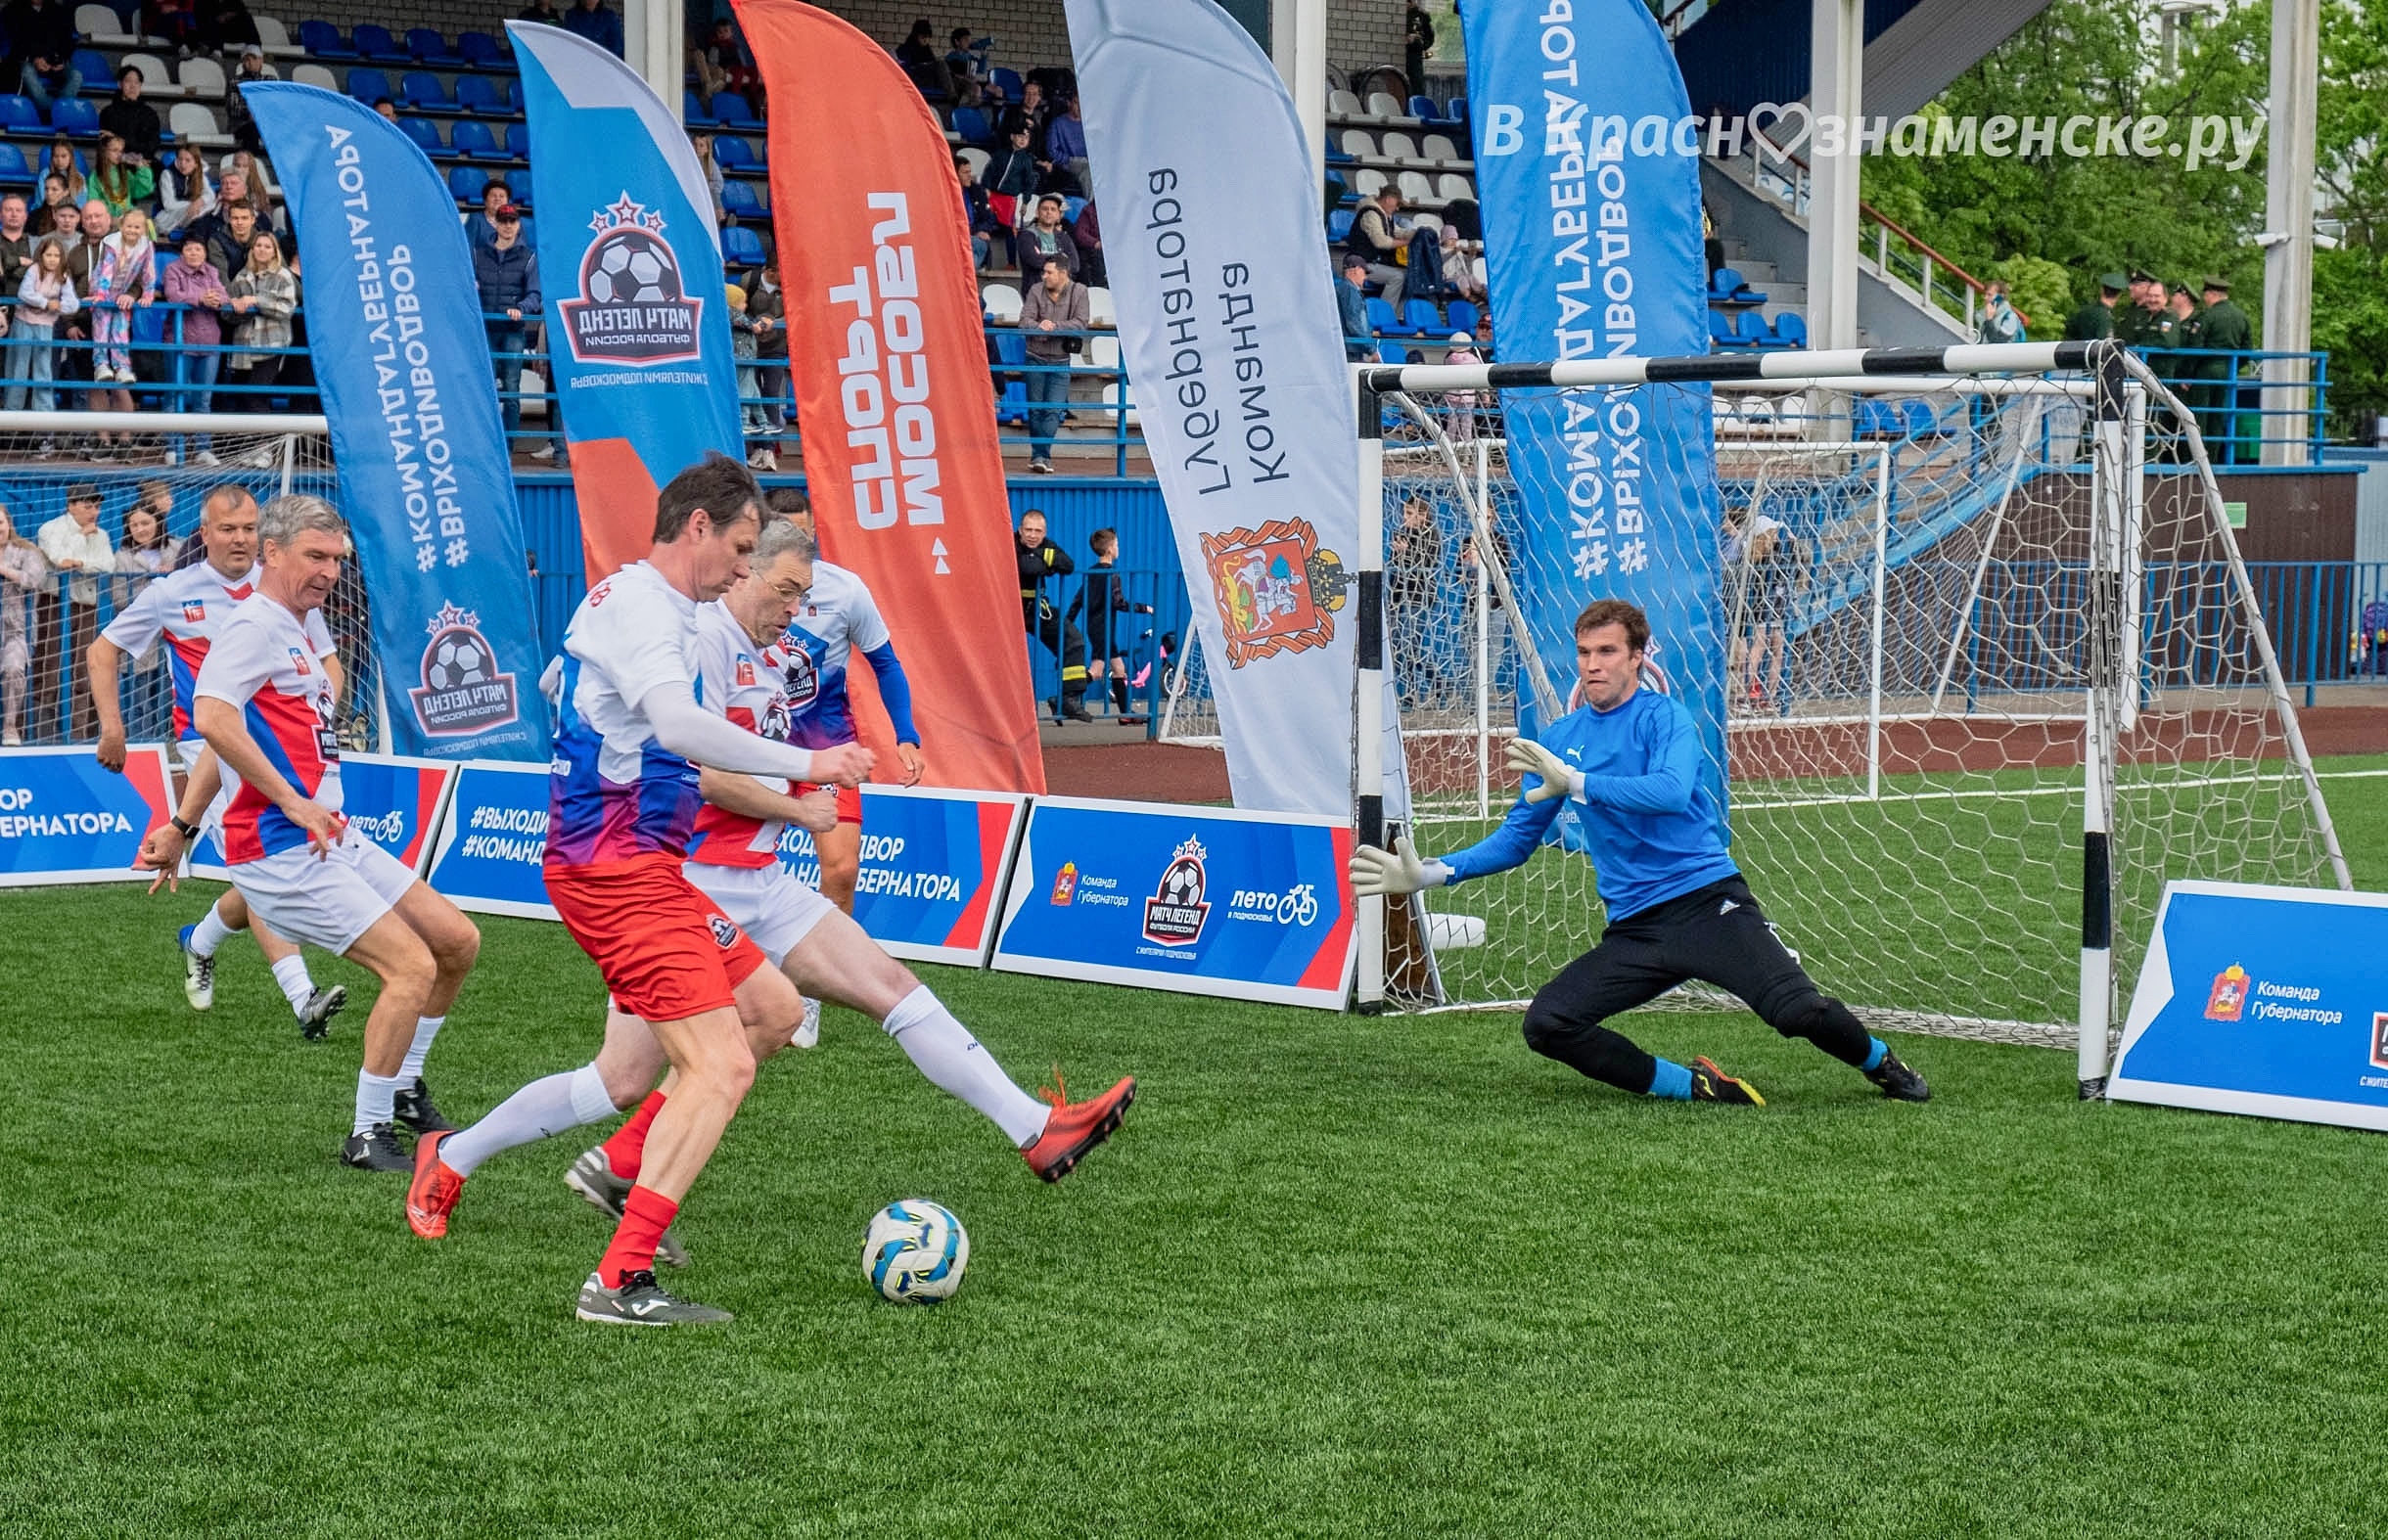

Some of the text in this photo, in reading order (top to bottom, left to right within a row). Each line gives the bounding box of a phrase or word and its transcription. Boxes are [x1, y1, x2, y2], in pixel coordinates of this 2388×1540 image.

[1080, 875, 1118, 889] Команда
[1078, 890, 1128, 907] Губернатора
[1150, 906, 1201, 926] МАТЧ ЛЕГЕНД
[2257, 980, 2320, 1002] Команда
[2251, 1001, 2343, 1025] Губернатора
